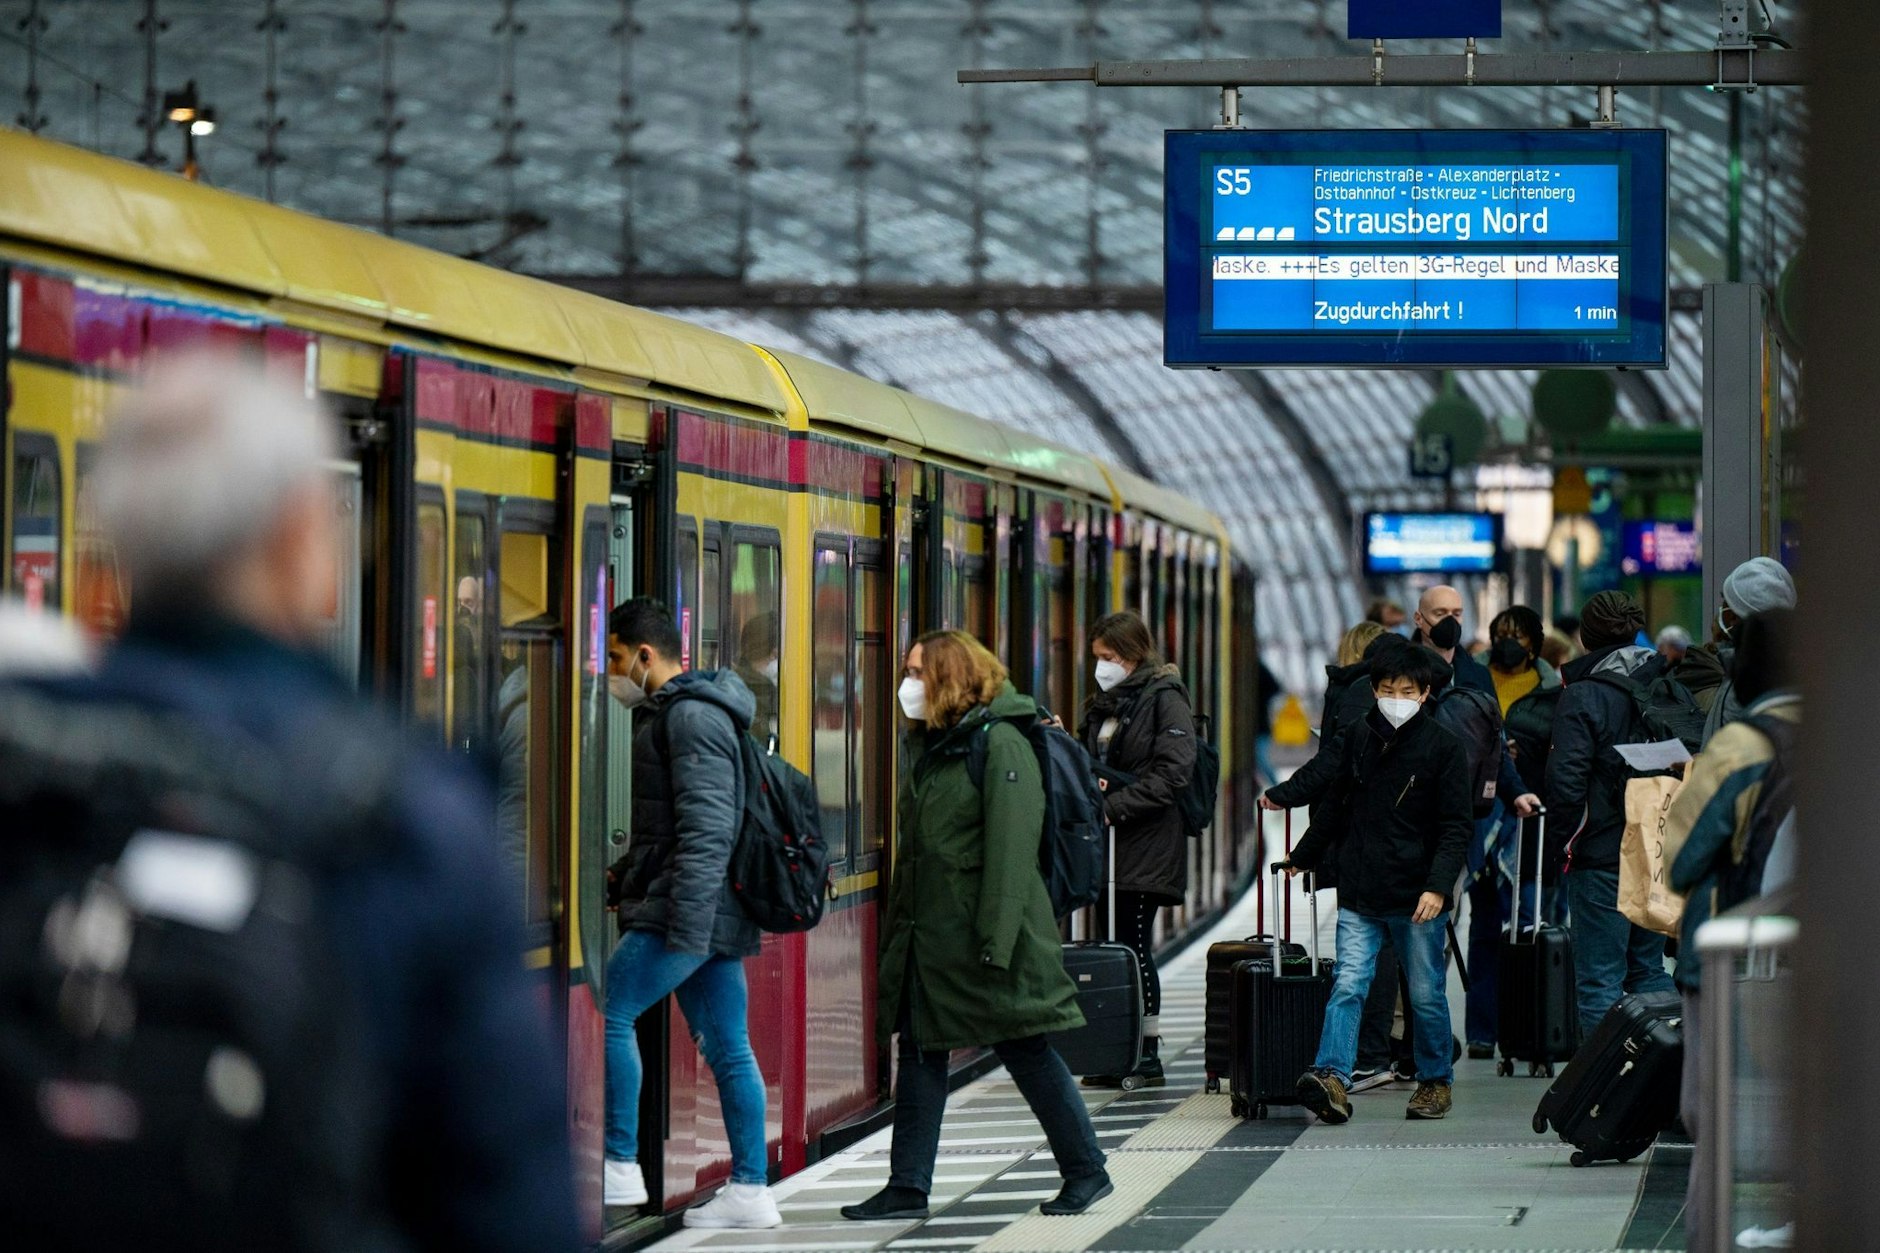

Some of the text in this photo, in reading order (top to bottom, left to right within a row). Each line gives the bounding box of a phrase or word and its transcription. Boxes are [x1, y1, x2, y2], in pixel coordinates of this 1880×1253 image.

[1216, 168, 1251, 196] S5
[1314, 168, 1424, 183] Friedrichstraße
[1438, 168, 1550, 184] Alexanderplatz
[1314, 186, 1396, 200] Ostbahnhof
[1411, 186, 1477, 200] Ostkreuz
[1491, 186, 1576, 203] Lichtenberg
[1314, 206, 1548, 241] Strausberg Nord
[1350, 256, 1408, 278] gelten
[1418, 256, 1505, 278] 3G-Regel
[1515, 256, 1547, 273] und
[1556, 256, 1619, 274] Maske
[1314, 301, 1450, 325] Zugdurchfahrt
[1573, 306, 1617, 320] 1 min
